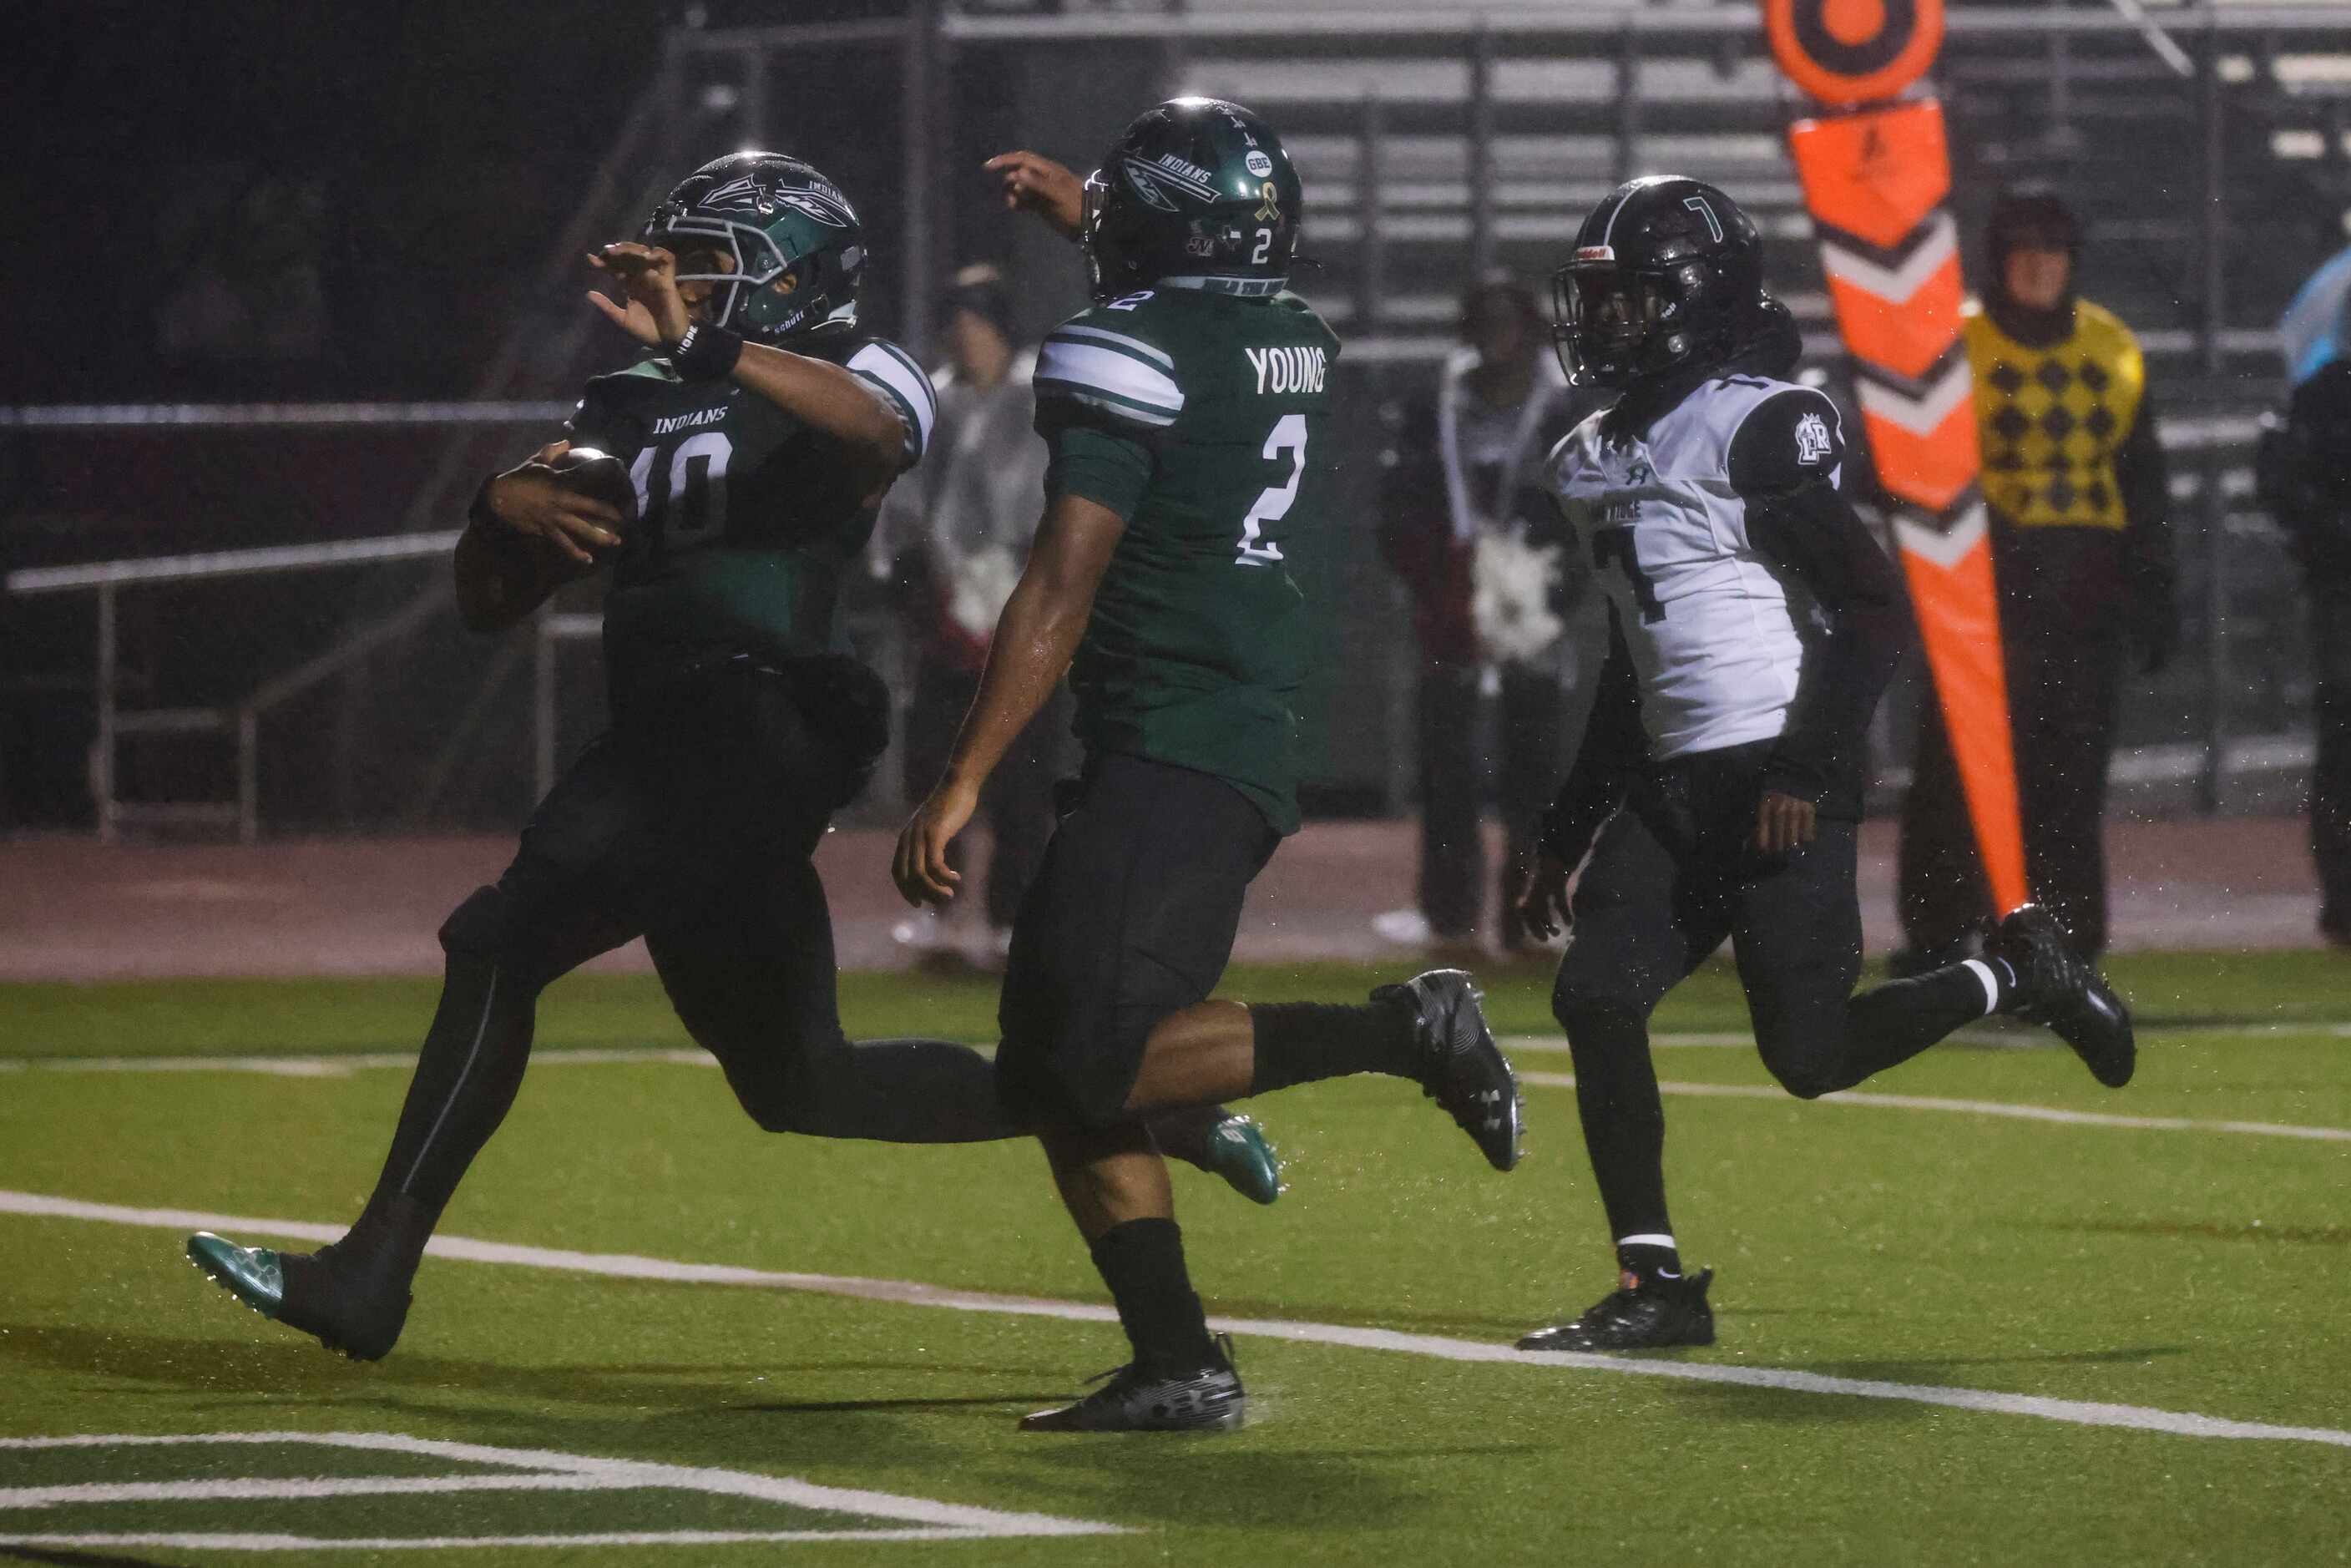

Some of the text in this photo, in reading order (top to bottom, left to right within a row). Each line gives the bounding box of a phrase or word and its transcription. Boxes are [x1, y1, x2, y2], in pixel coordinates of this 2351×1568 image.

[1159, 154, 1211, 184] INDIANS
[1247, 158, 1270, 170] GBE
[1251, 228, 1272, 264] 2
[1107, 291, 1155, 311] 2
[1245, 347, 1327, 394] YOUNG
[653, 406, 728, 435] INDIANS
[629, 432, 733, 539] 10
[1235, 414, 1308, 566] 2
